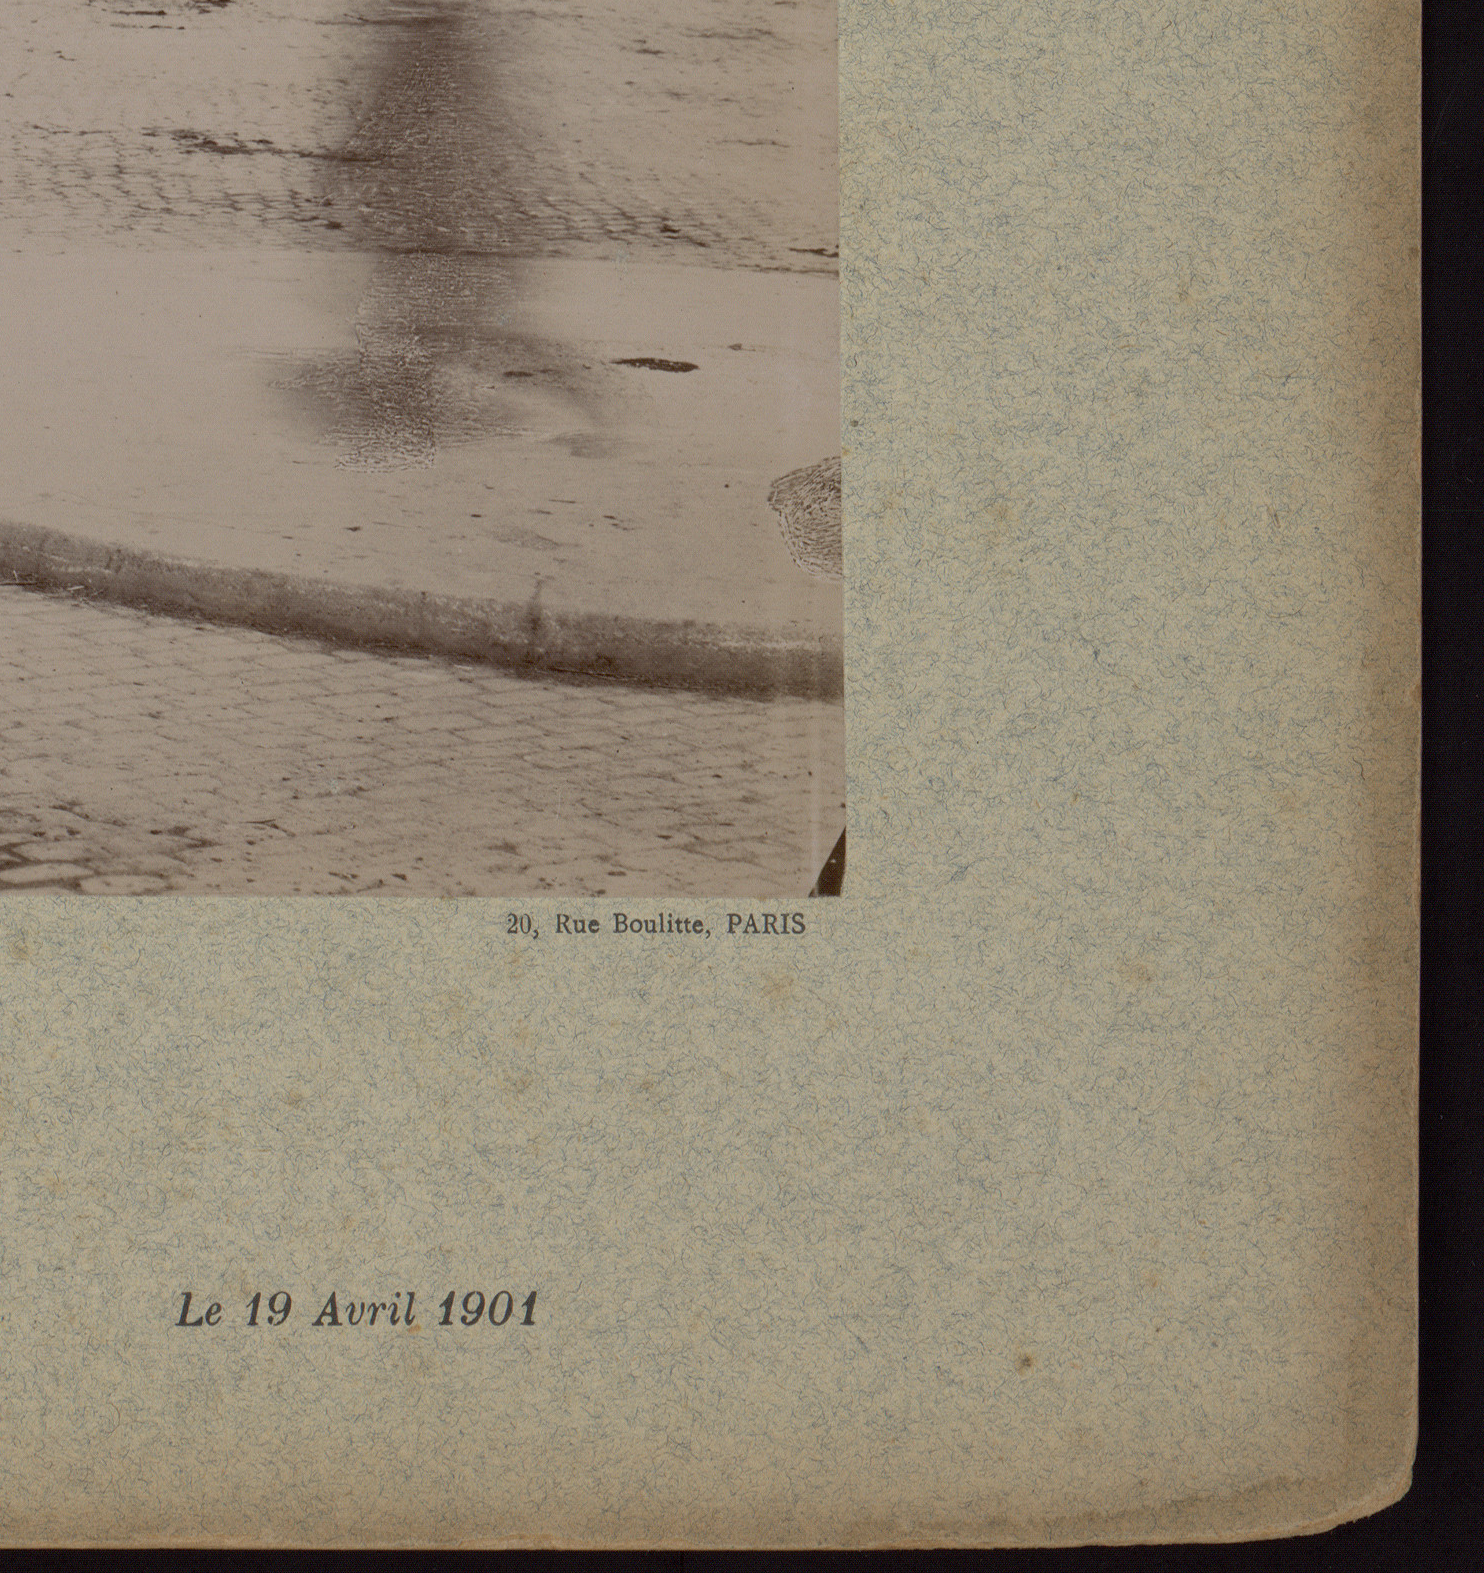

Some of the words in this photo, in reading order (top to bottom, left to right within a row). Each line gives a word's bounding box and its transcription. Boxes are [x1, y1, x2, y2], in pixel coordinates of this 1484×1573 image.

[506, 914, 540, 939] 20,
[555, 913, 601, 935] Rue
[613, 913, 712, 938] Boulitte,
[726, 913, 807, 935] PARIS
[175, 1291, 223, 1327] Le
[245, 1291, 293, 1327] 19
[311, 1291, 417, 1327] Avril
[438, 1291, 538, 1327] 1901
